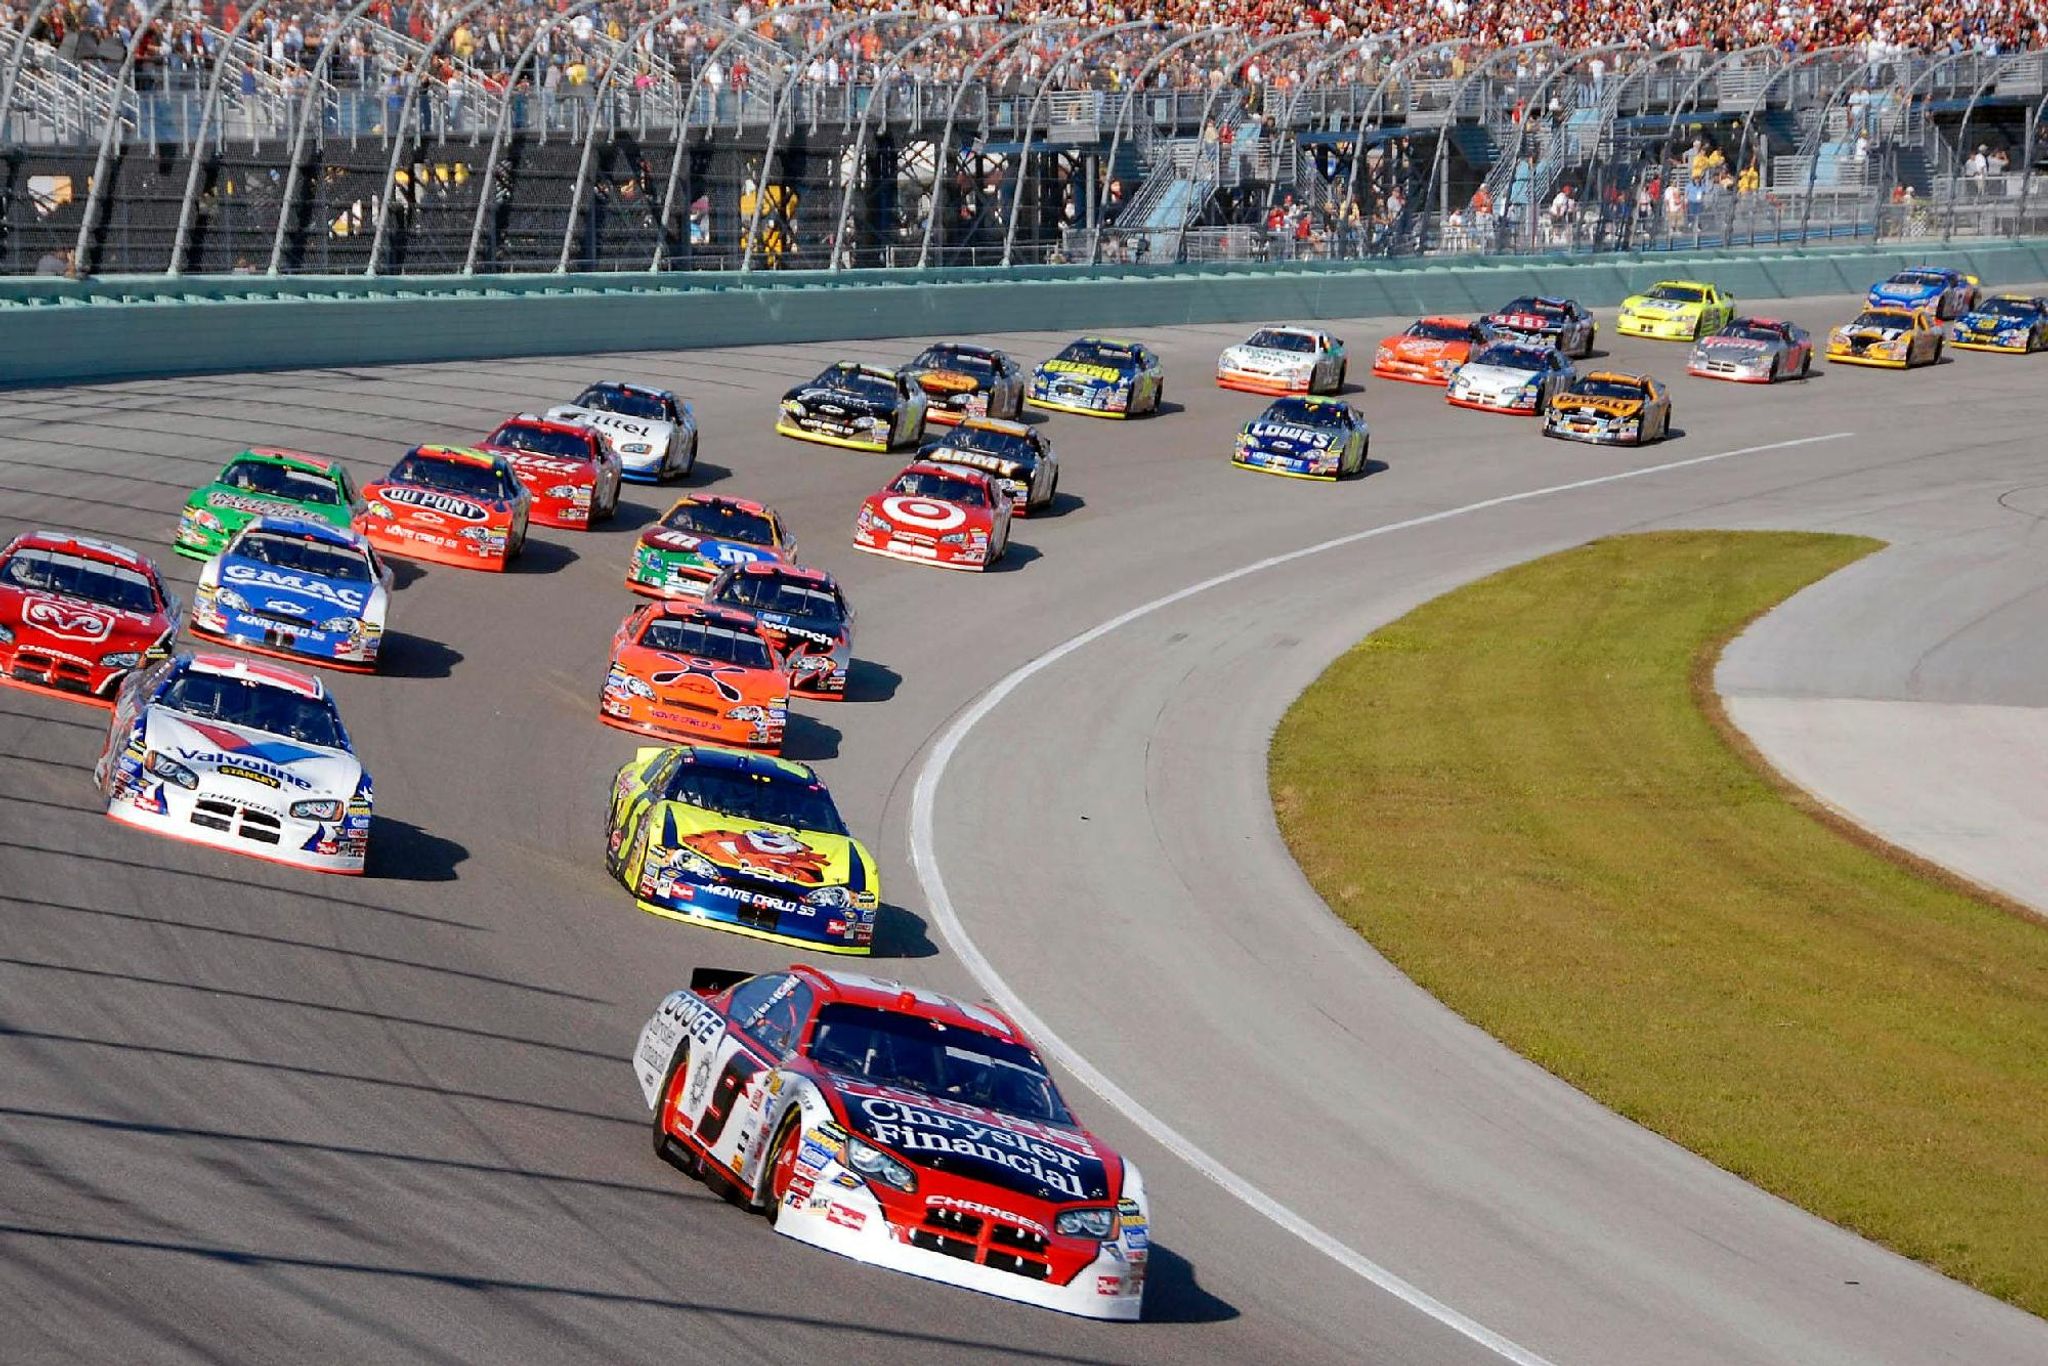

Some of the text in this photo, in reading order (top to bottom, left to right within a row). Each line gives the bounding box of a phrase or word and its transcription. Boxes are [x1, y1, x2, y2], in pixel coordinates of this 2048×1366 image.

[423, 494, 480, 519] PONT
[224, 565, 363, 607] GMAC
[237, 614, 274, 629] MONTE
[762, 620, 833, 646] wrench
[176, 746, 312, 791] Valvoline
[220, 766, 280, 789] STANLEY
[198, 792, 284, 818] CHARGER
[703, 882, 752, 904] MONTE
[753, 894, 796, 913] CARLO
[797, 904, 816, 917] SS
[663, 992, 724, 1045] DODGE
[861, 1098, 1081, 1173] Chrysler
[868, 1120, 1088, 1199] Financial
[926, 1195, 1050, 1237] CHARGER
